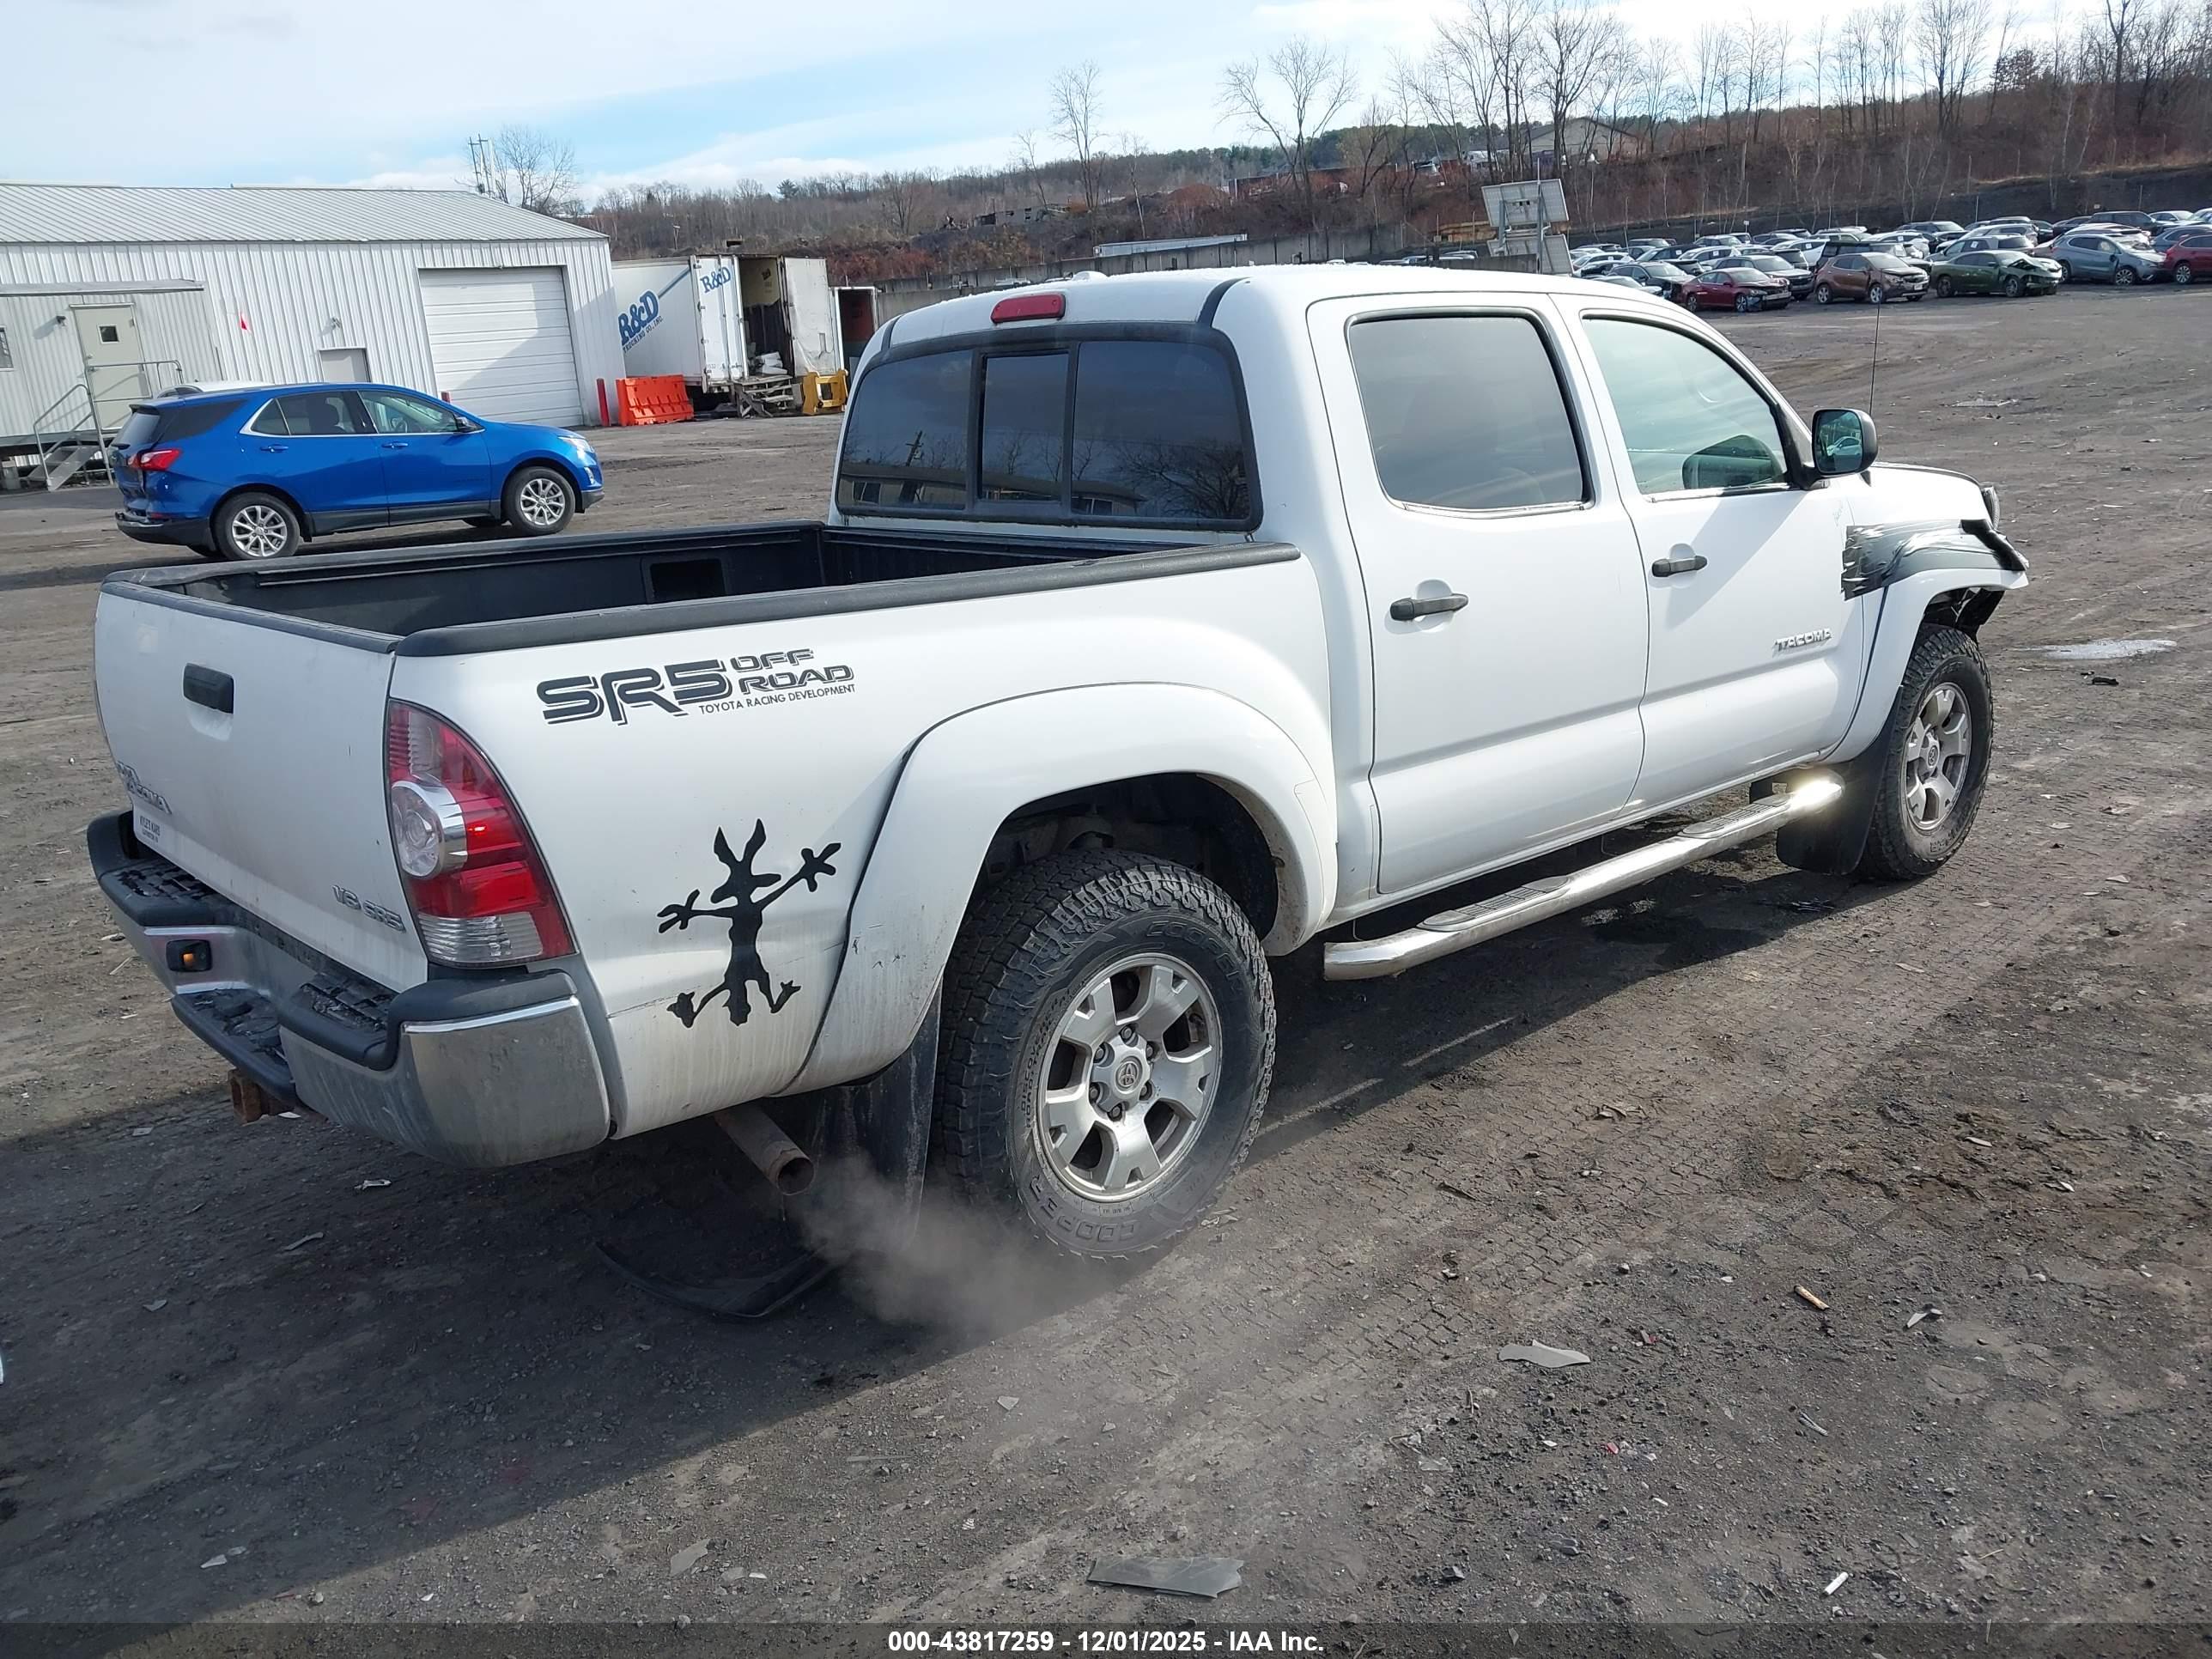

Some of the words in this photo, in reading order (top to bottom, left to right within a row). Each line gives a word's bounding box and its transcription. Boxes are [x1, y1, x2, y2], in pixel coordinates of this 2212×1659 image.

[700, 267, 731, 294] R&D
[618, 290, 659, 346] R&D
[1774, 628, 1832, 651] TACOMA
[730, 648, 815, 672] OFF
[537, 659, 733, 726] SR5
[738, 665, 854, 695] ROAD
[699, 701, 744, 714] TOYOTA
[747, 694, 786, 708] RACING
[789, 684, 855, 701] DEVELOPMENT
[331, 884, 362, 910] V6
[1030, 1173, 1140, 1242] COOPER
